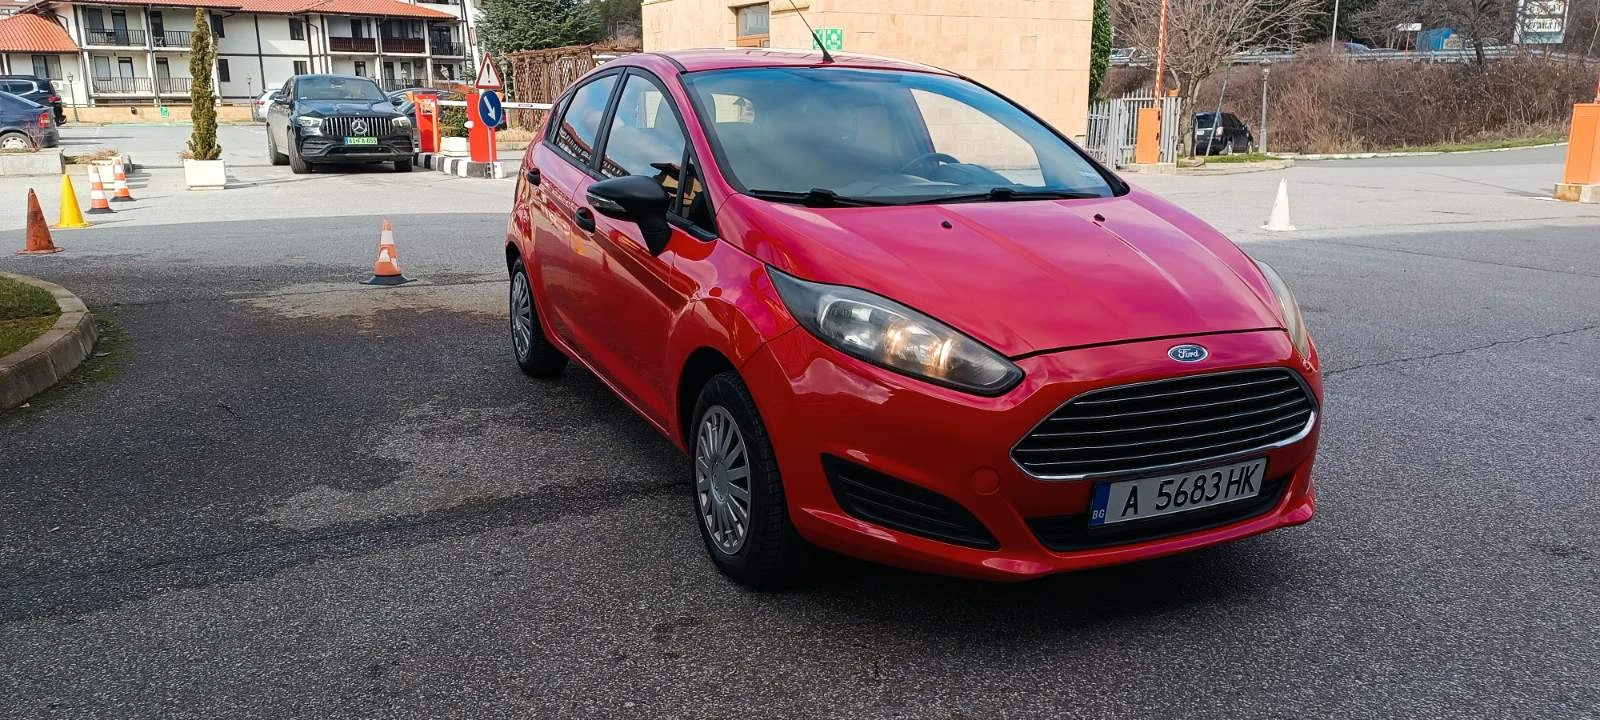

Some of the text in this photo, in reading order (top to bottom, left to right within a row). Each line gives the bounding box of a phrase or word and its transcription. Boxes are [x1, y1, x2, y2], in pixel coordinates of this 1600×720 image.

[1178, 348, 1200, 359] Ford
[1121, 485, 1139, 517] A
[1092, 508, 1105, 519] BG
